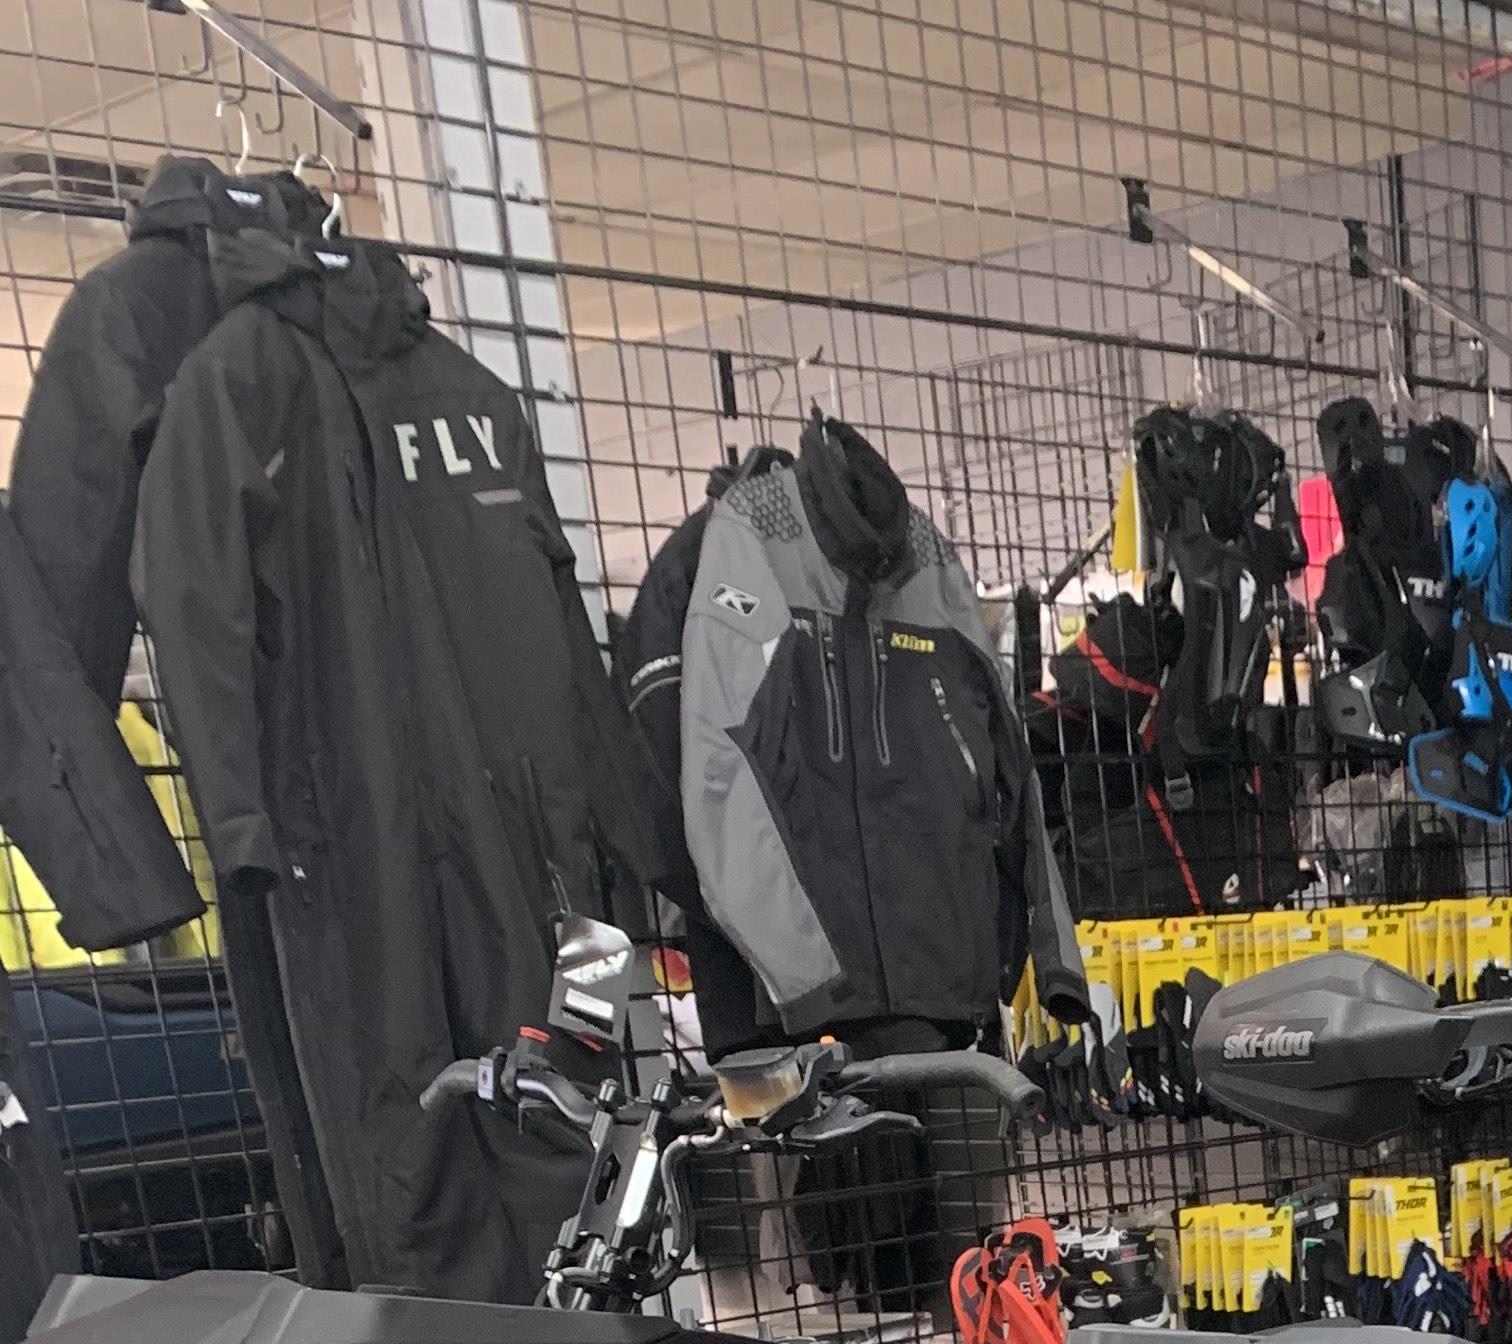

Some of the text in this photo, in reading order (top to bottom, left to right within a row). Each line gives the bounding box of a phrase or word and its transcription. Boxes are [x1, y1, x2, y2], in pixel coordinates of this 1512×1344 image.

[393, 414, 502, 482] FLY
[1223, 1025, 1314, 1060] ski-doo
[1396, 1197, 1428, 1211] THOR
